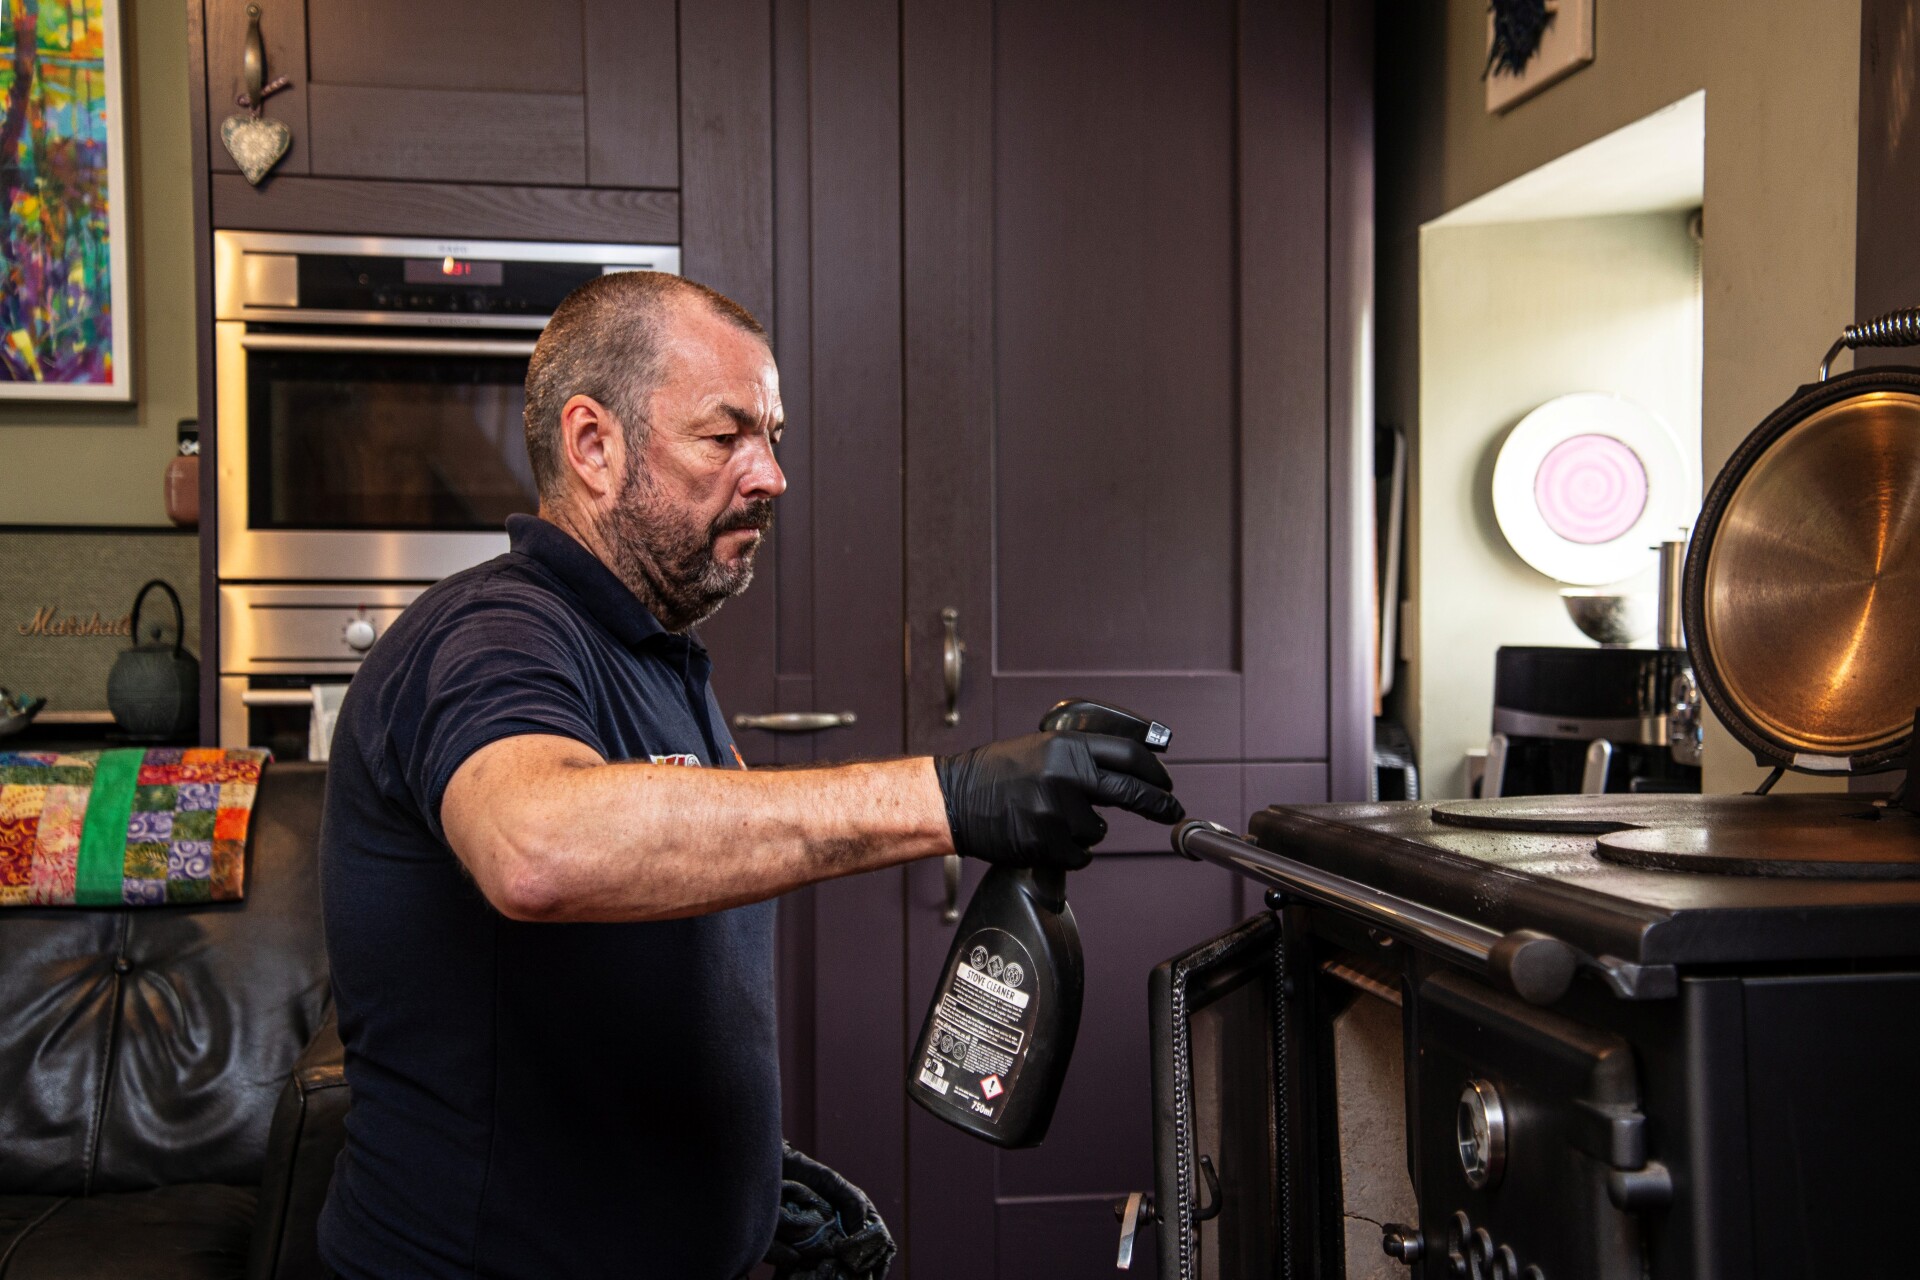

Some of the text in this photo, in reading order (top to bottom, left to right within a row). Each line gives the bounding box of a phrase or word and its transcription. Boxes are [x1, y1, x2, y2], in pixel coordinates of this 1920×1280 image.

[966, 970, 986, 986] STOVE
[986, 980, 1016, 1001] CLEANER
[971, 1100, 993, 1117] 750ml
